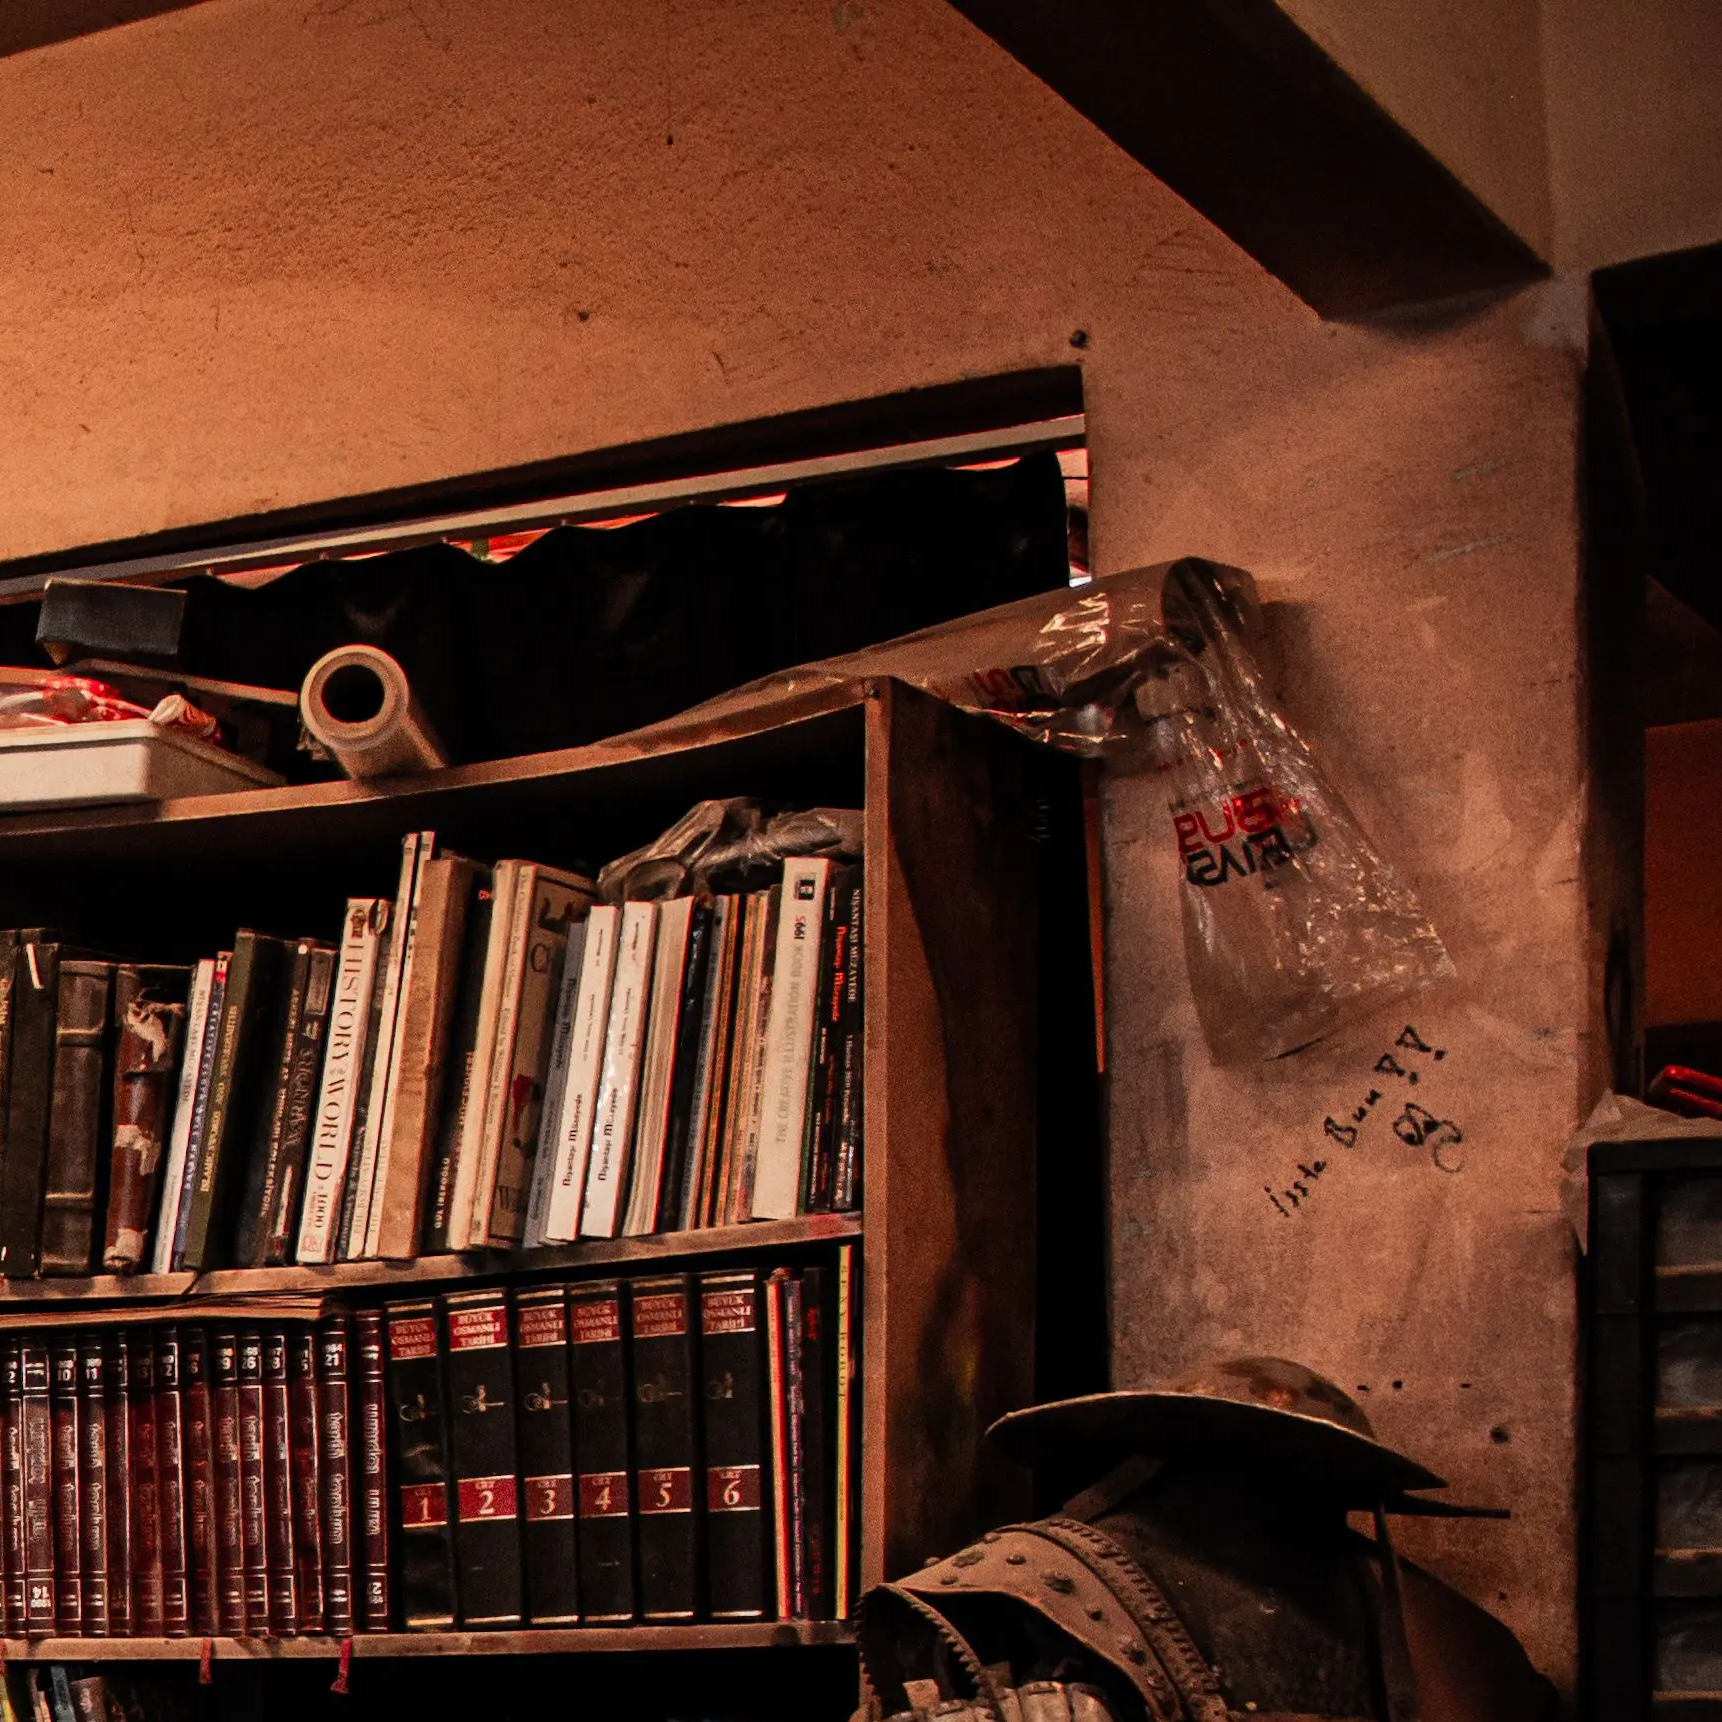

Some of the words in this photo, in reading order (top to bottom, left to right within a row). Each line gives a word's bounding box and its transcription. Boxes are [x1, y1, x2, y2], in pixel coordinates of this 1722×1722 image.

[331, 944, 363, 1067] HISTORY
[314, 1077, 347, 1182] WORLD
[478, 1491, 494, 1514] 2
[541, 1490, 556, 1513] 3
[594, 1484, 612, 1509] 4
[656, 1483, 672, 1508] 5
[722, 1482, 739, 1505] 6
[418, 1497, 433, 1521] 1
